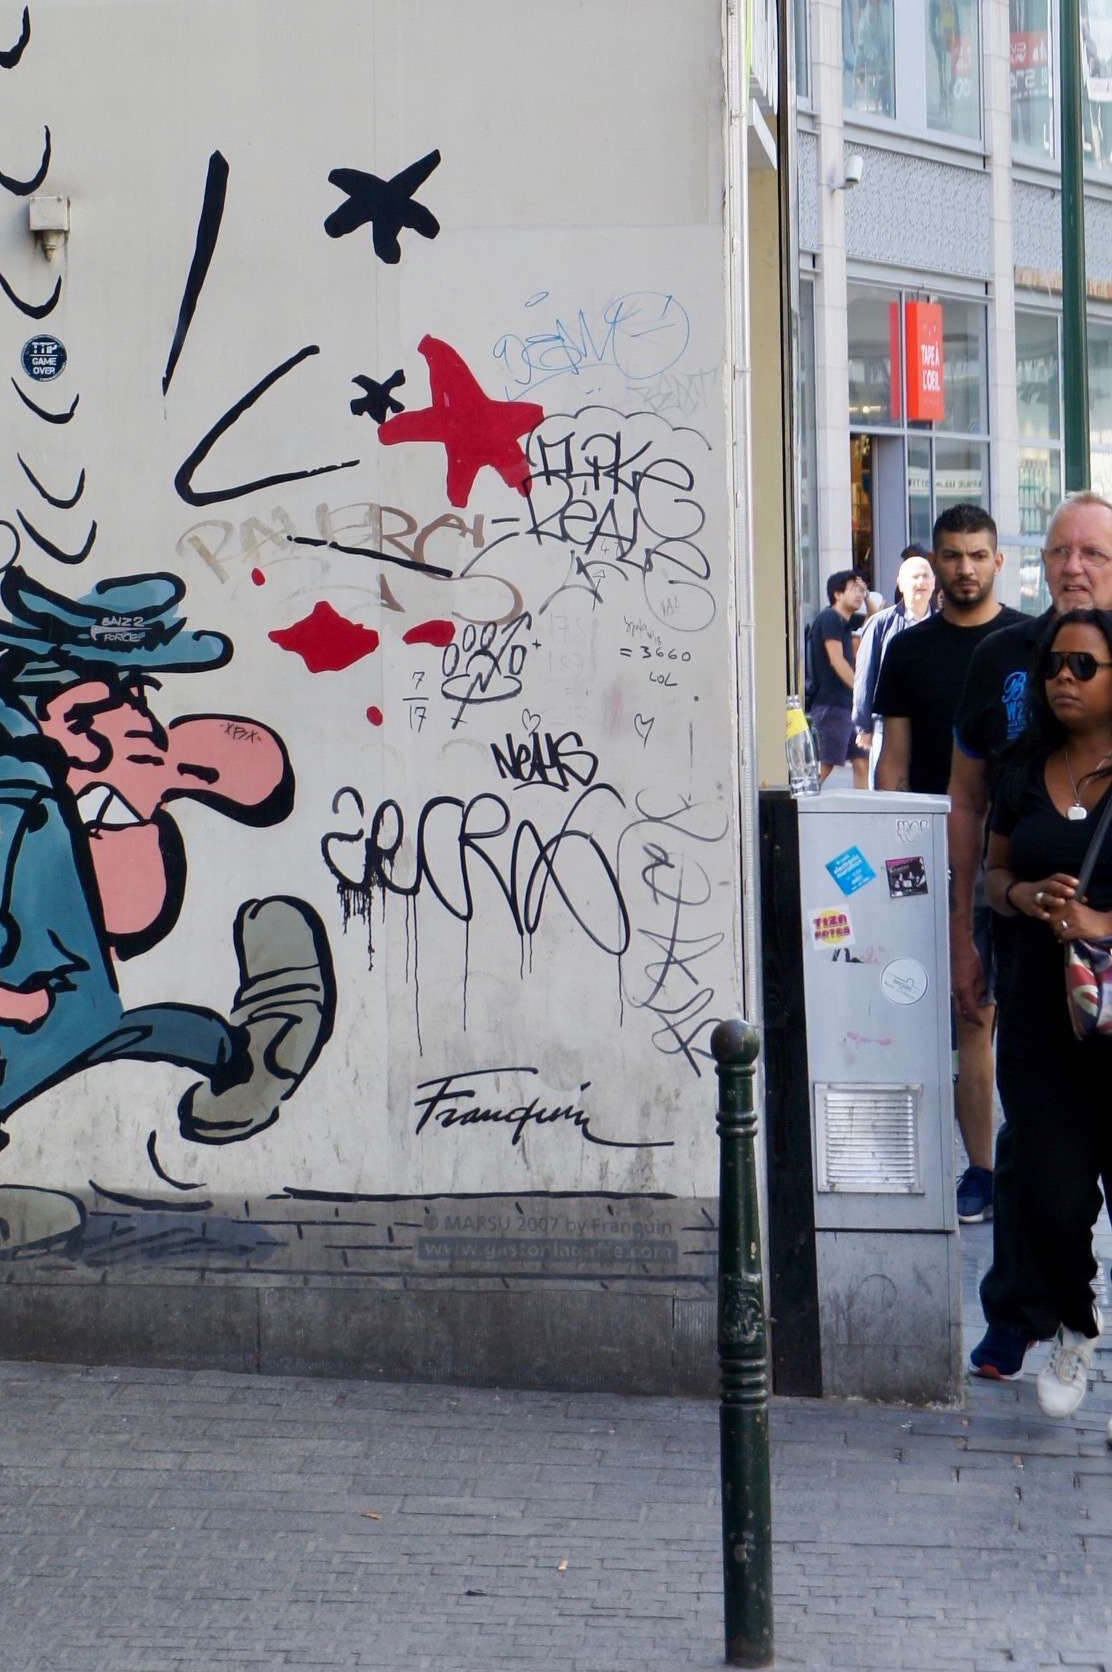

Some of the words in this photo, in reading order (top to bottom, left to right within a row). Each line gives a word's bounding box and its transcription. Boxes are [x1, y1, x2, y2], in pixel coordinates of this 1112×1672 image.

[920, 343, 935, 366] TAPE
[31, 357, 57, 366] GAME
[32, 366, 56, 375] OVER
[103, 632, 142, 643] FORCE
[649, 671, 678, 687] LOL
[444, 1215, 511, 1231] MARSU
[517, 1216, 559, 1232] 2007
[565, 1216, 590, 1236] by
[591, 1220, 673, 1239] Franquin
